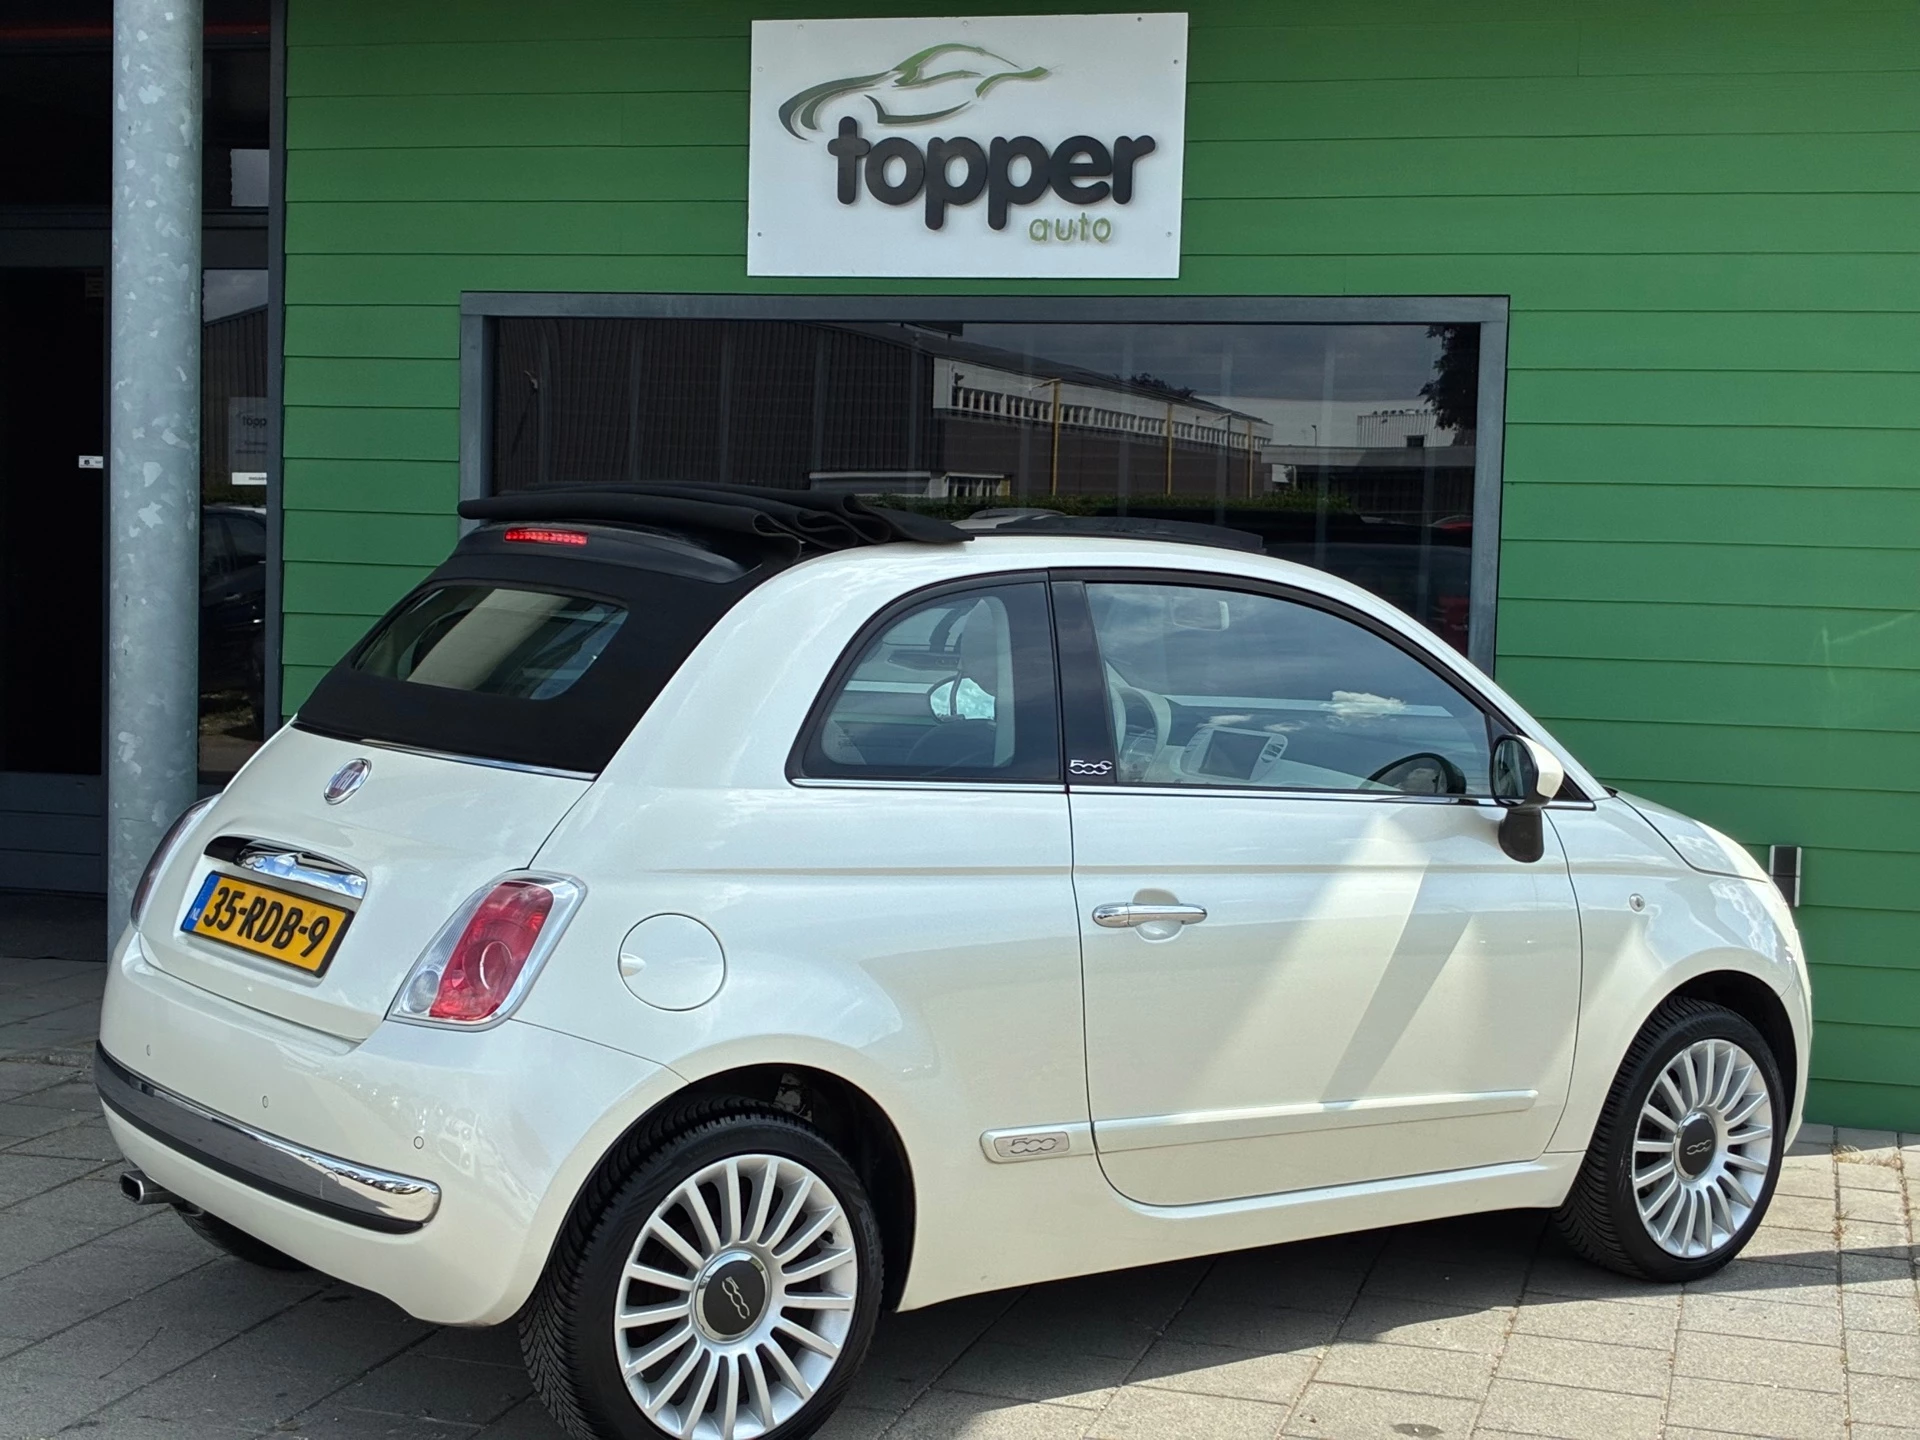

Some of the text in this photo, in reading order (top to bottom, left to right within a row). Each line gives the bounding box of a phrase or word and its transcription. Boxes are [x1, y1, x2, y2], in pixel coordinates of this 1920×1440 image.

[827, 115, 1157, 231] topper
[1028, 211, 1113, 244] auto
[203, 886, 330, 957] 35-RDB-9
[1009, 1137, 1057, 1154] 500
[722, 1276, 750, 1319] 500
